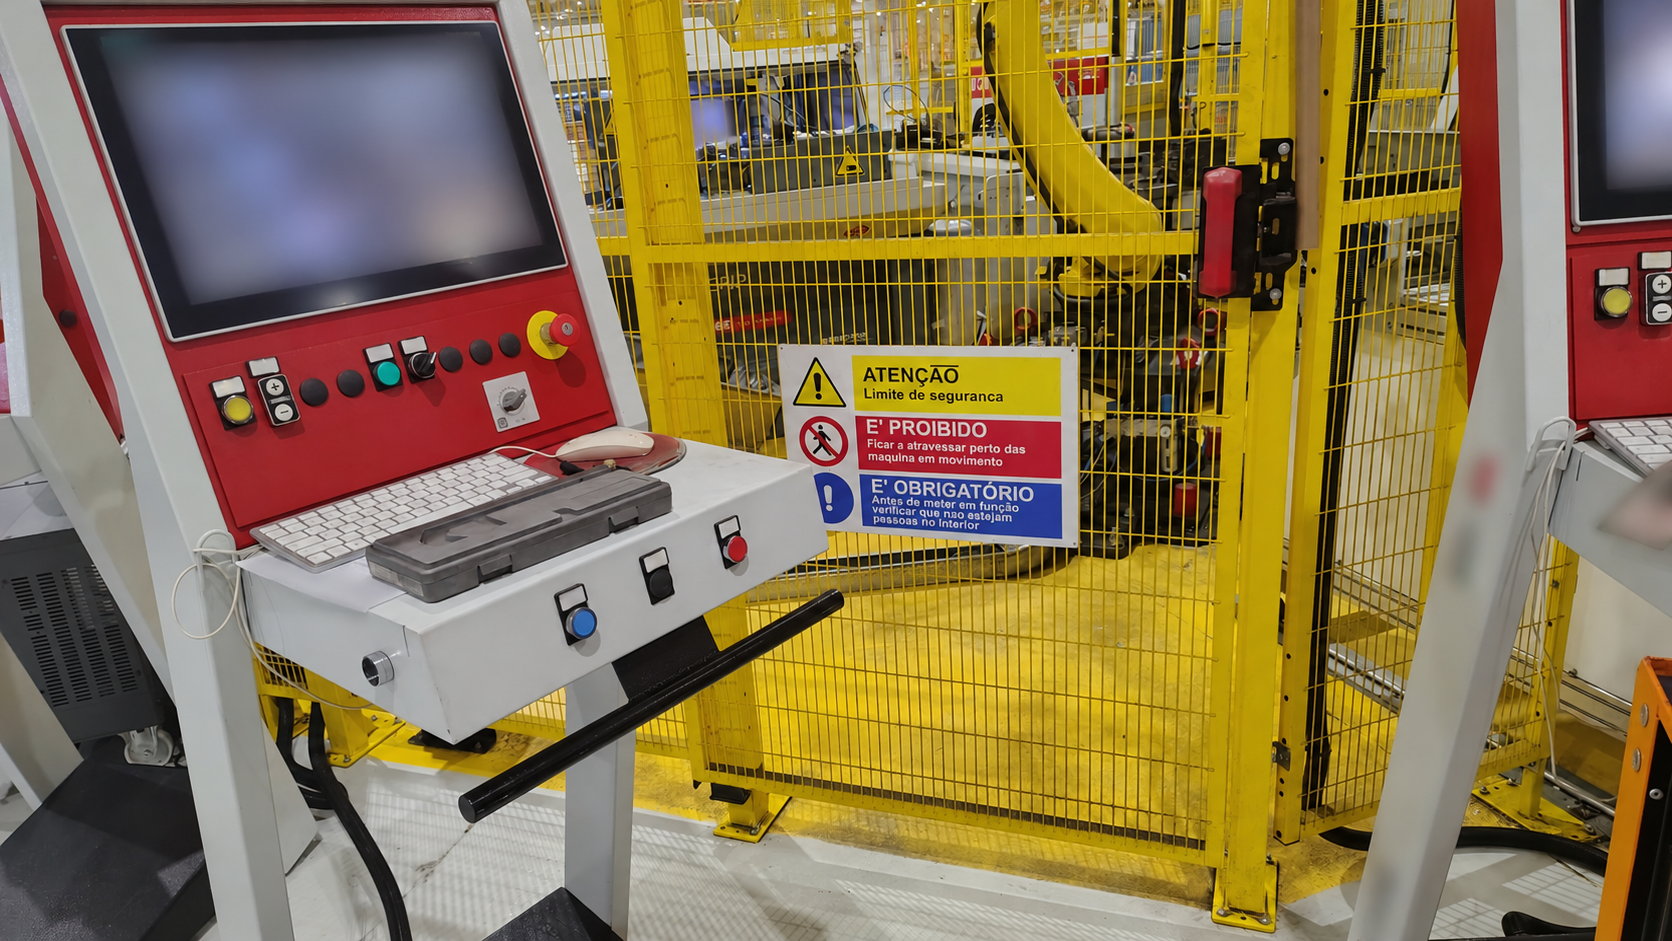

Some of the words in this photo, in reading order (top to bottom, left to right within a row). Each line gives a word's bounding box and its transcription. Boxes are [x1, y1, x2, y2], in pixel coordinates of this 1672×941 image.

[863, 388, 904, 400] Limite
[908, 389, 926, 401] de
[929, 390, 1004, 405] seguranca
[888, 419, 988, 438] PROIBIDO
[867, 438, 894, 450] Ficar
[897, 442, 904, 451] a
[906, 441, 967, 453] atravessar
[969, 444, 1000, 455] perto
[1003, 443, 1026, 455] das
[918, 455, 936, 464] em
[938, 455, 1004, 468] movimento
[894, 480, 1034, 502] OBRIGATÓRIO
[871, 495, 904, 506] Antes
[906, 497, 921, 507] de
[923, 499, 957, 509] meter
[959, 503, 977, 511] em
[979, 501, 1020, 515] função
[872, 505, 916, 516] verificar
[919, 509, 941, 519] que
[967, 511, 1013, 523] estejam
[873, 515, 919, 526] pessoas
[921, 518, 937, 527] no
